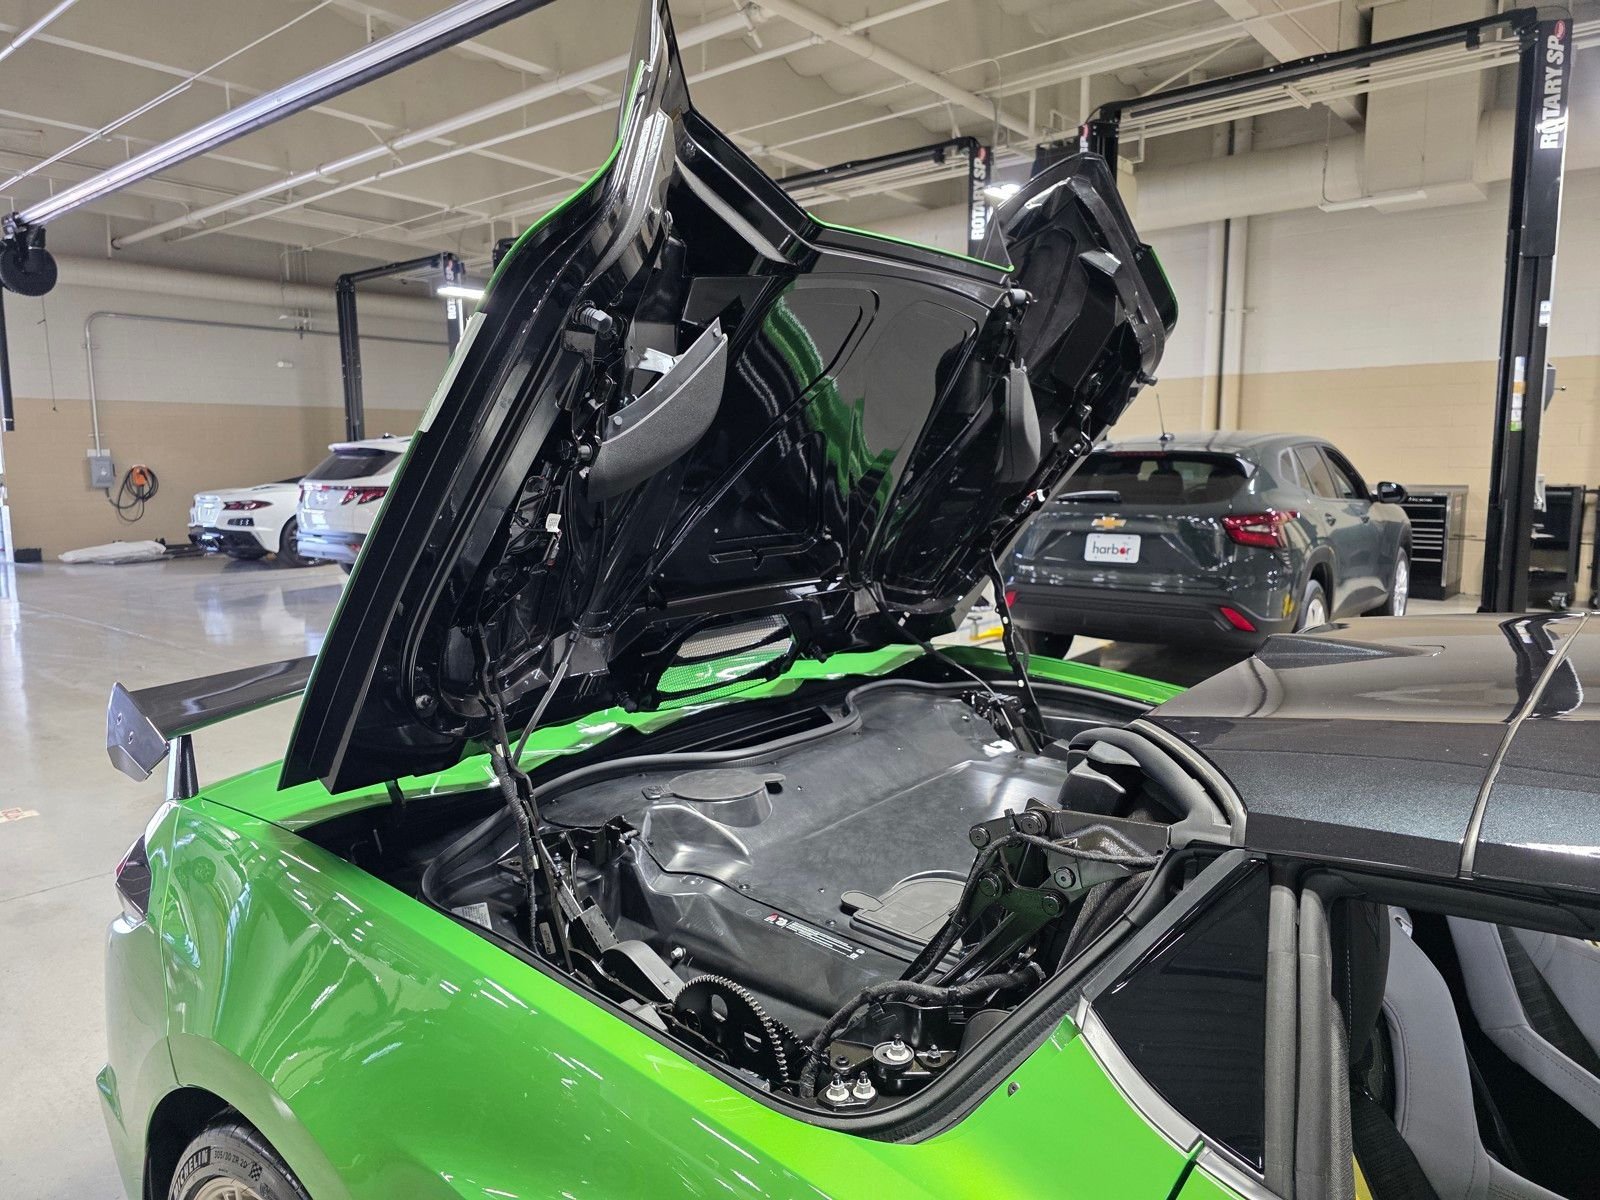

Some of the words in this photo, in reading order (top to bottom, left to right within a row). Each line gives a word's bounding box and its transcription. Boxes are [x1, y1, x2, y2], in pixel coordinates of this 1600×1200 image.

[1546, 35, 1565, 65] SP
[1539, 66, 1563, 149] ROTARY
[1091, 540, 1132, 555] harbor
